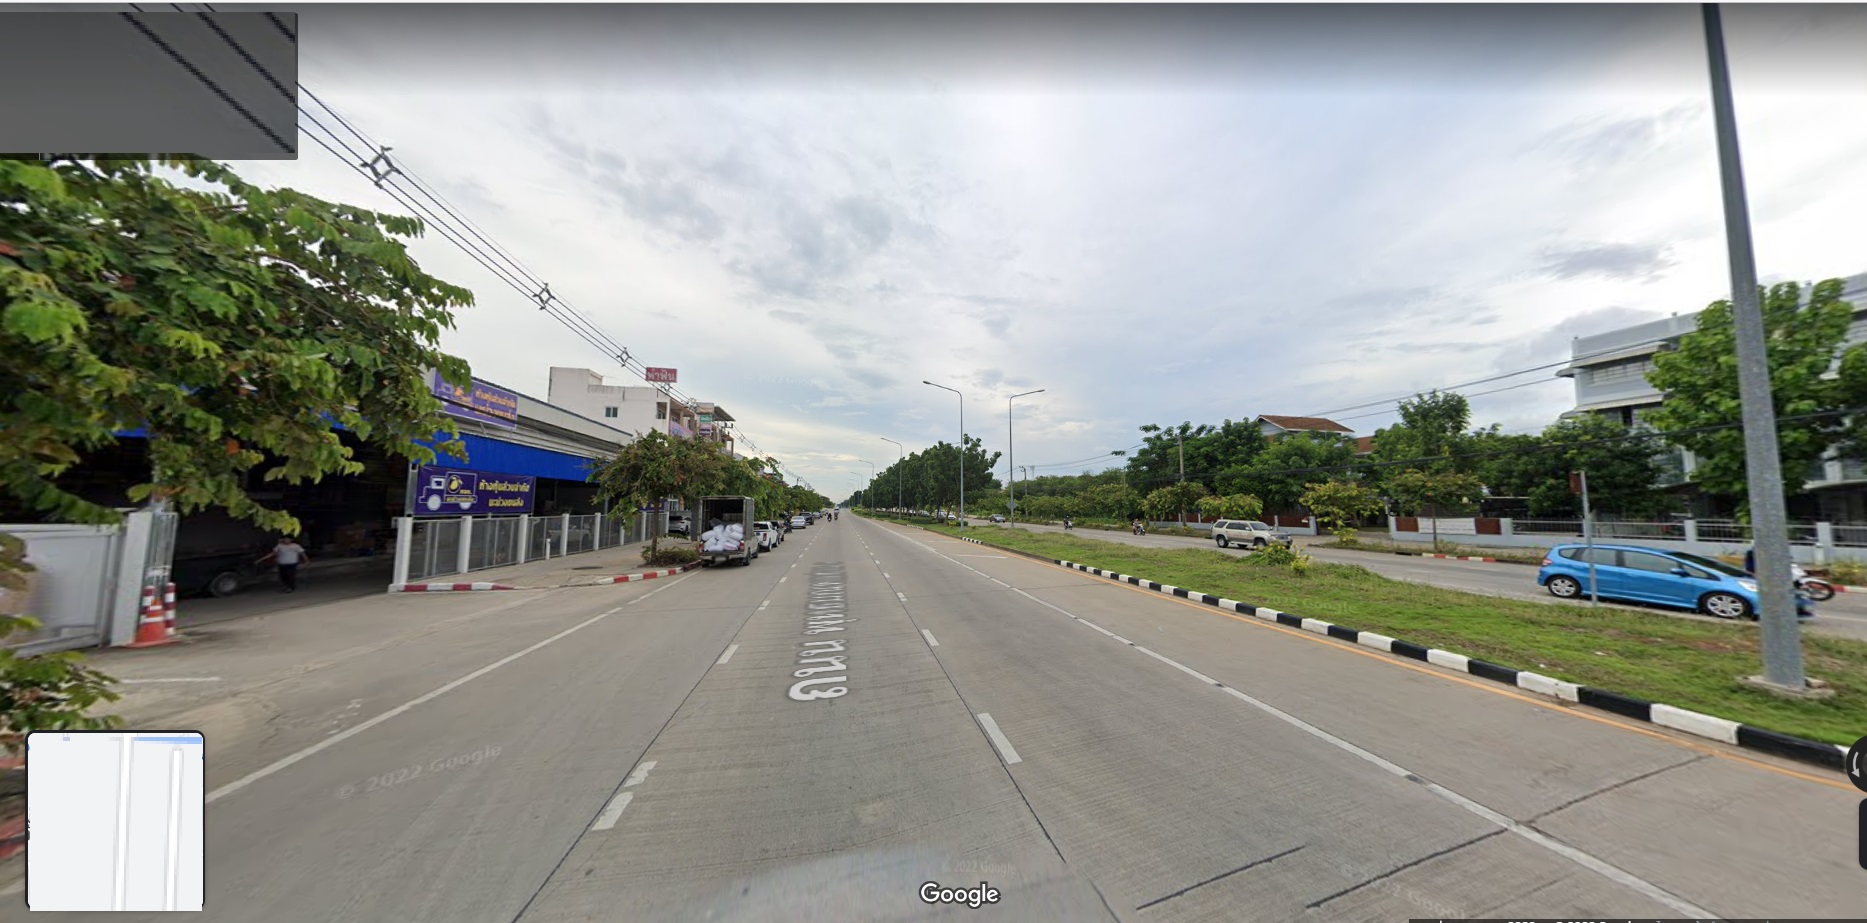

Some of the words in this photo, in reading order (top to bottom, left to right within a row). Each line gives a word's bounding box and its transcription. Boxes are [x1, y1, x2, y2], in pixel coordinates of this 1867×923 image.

[478, 479, 530, 494] ห้างหุ้นส่วนจำกัด
